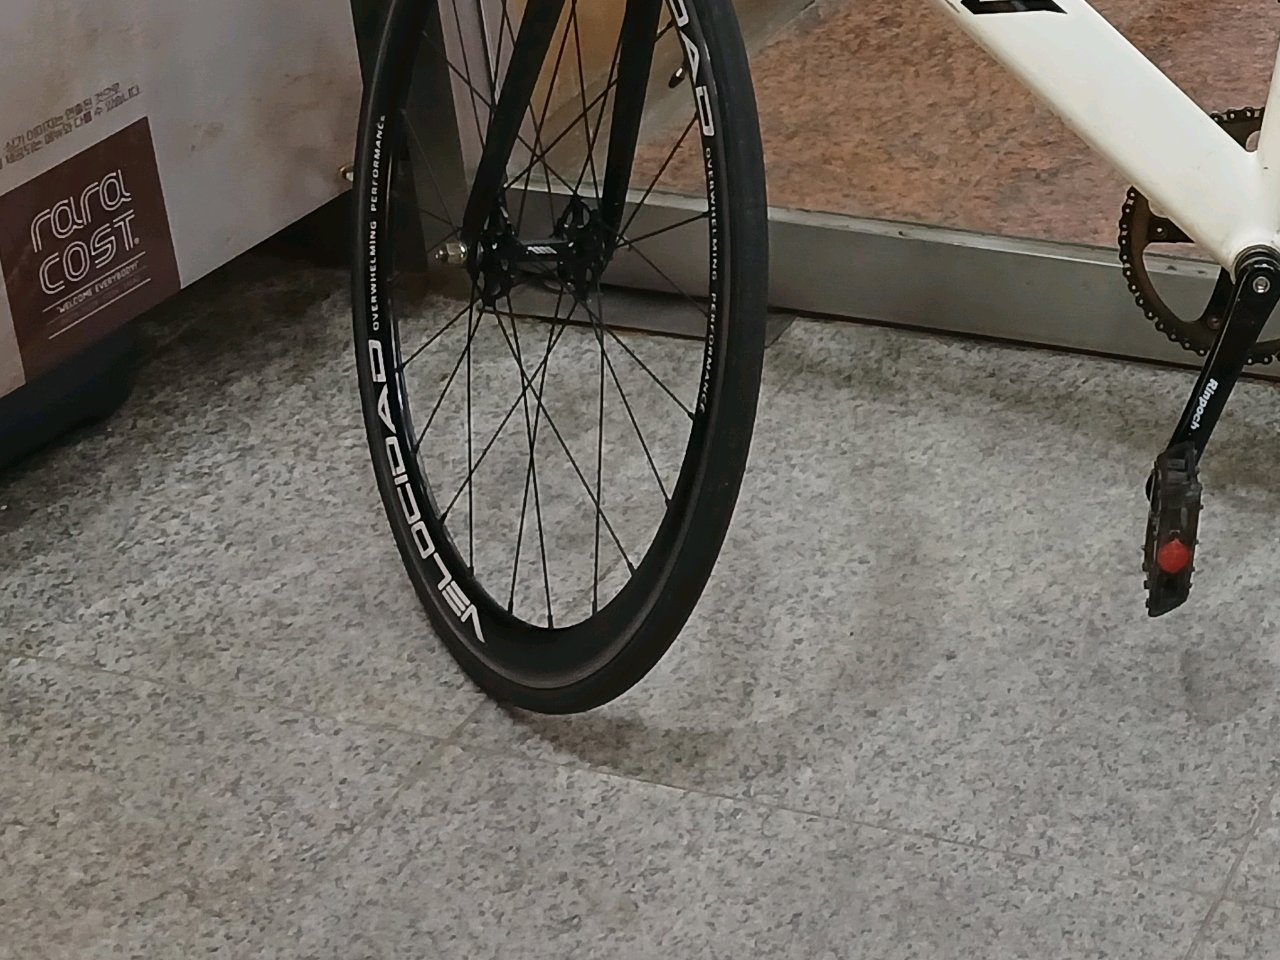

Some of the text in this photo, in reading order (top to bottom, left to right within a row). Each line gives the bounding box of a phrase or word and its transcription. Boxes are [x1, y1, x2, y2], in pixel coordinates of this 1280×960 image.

[30, 169, 132, 253] rara
[39, 209, 136, 295] COST
[368, 114, 386, 332] OVERWHELMING PERFORMANCE
[699, 147, 718, 414] OVERWHELMING PERFORMANCE
[368, 339, 486, 643] VELOCIDAD
